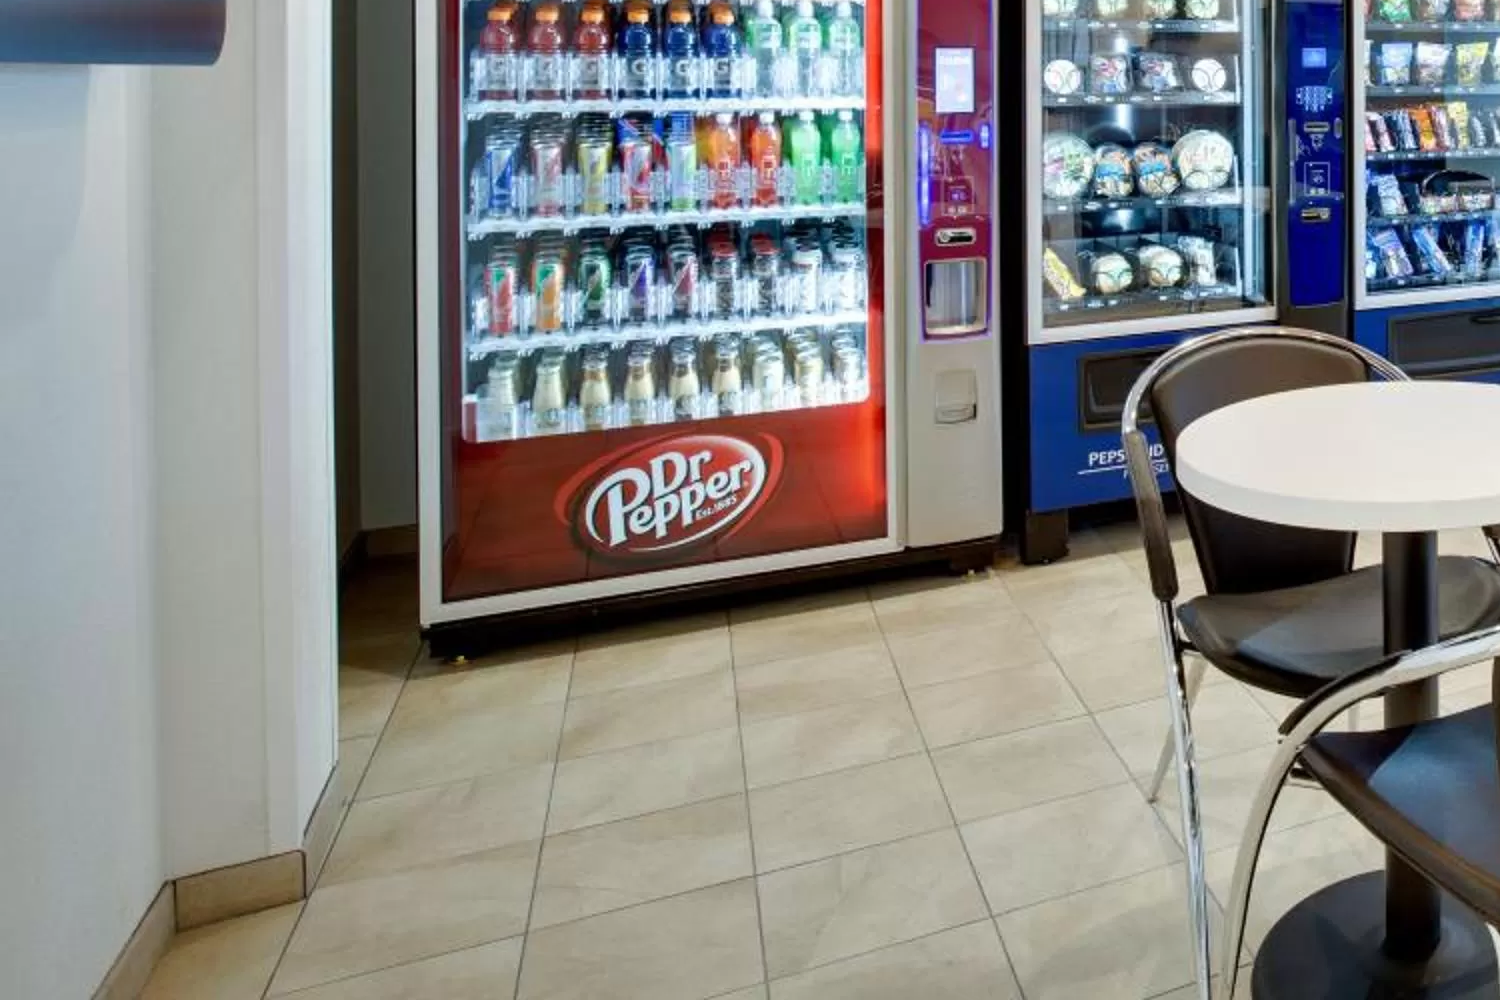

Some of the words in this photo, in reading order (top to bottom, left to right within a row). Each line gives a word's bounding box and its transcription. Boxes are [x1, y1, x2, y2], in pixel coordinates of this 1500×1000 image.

[650, 451, 713, 499] Dr
[1088, 449, 1125, 467] PEPS
[606, 458, 751, 548] Pepper
